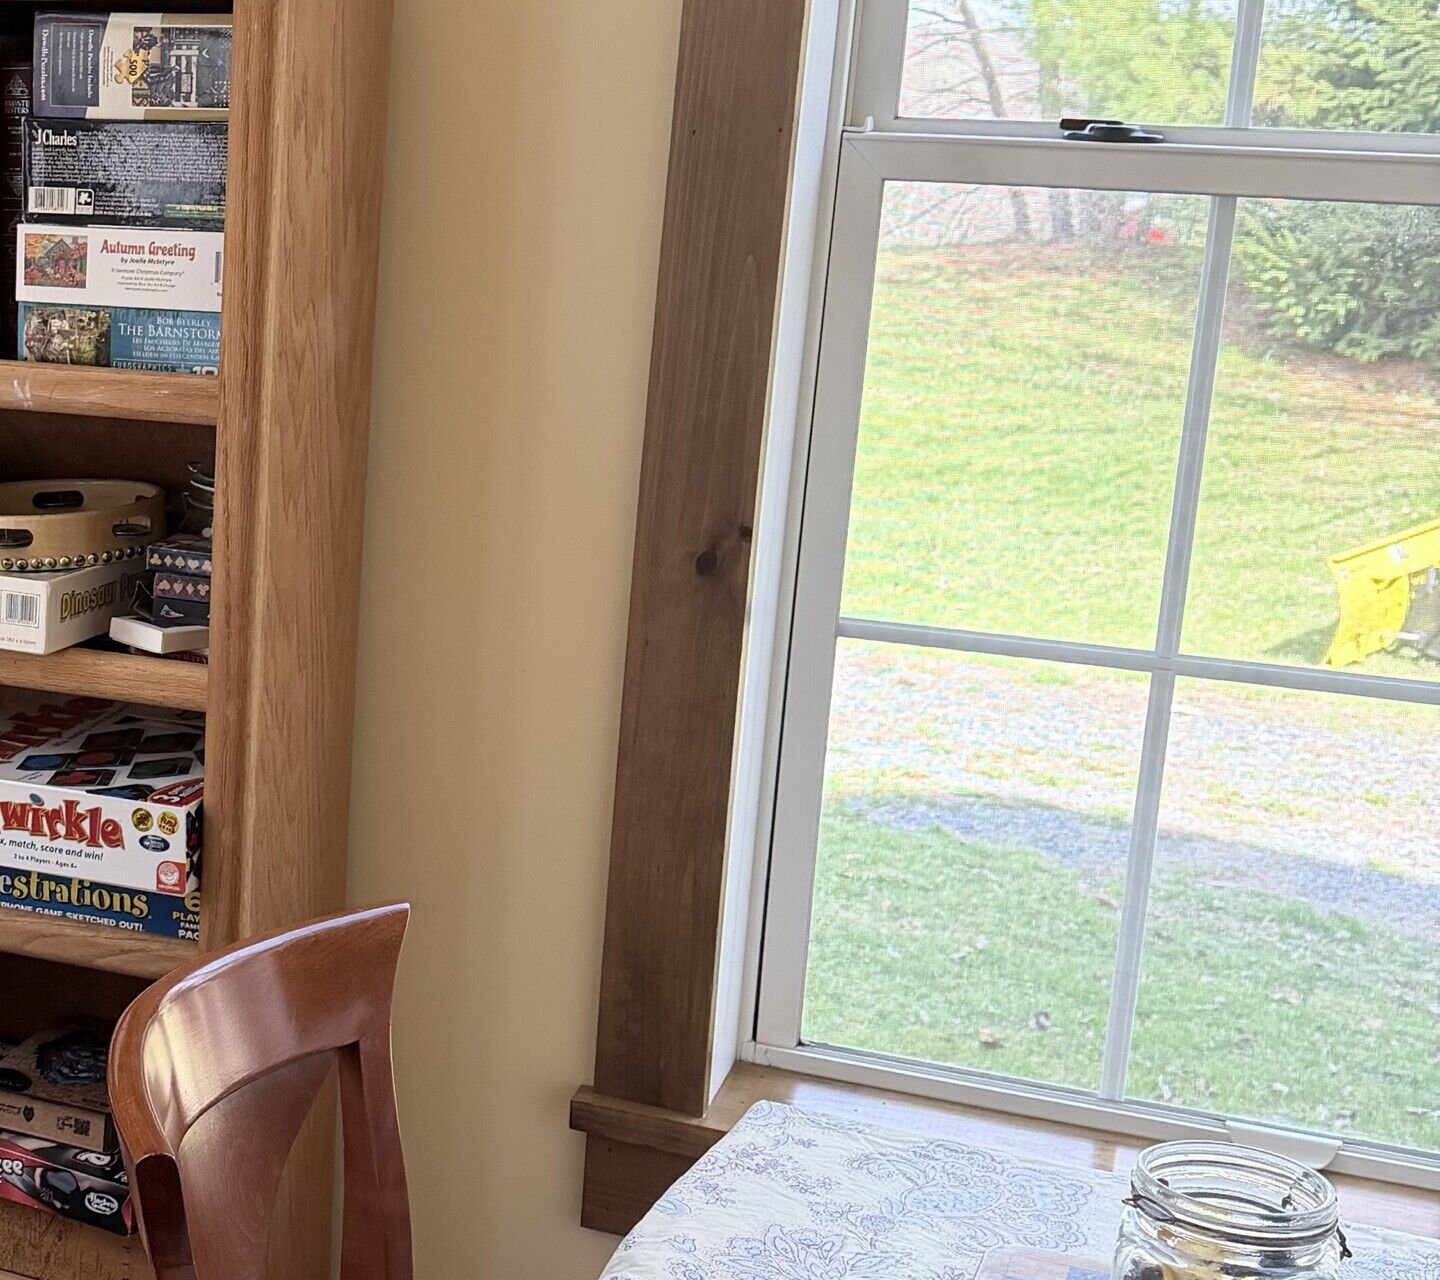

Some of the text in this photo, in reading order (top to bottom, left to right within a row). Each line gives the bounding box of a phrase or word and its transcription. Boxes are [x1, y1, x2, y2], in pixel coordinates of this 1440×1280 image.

[128, 58, 138, 77] 500
[43, 130, 78, 147] Charles
[100, 239, 196, 261] Autumn Greeting
[120, 257, 128, 265] by
[128, 257, 147, 265] Joelle
[118, 323, 144, 336] THE
[176, 317, 211, 328] BYERLEY
[61, 582, 117, 621] Dinosaur
[8, 839, 39, 852] match,
[40, 844, 64, 855] score
[65, 848, 83, 858] and
[84, 851, 104, 862] win!
[35, 907, 64, 917] GAME
[65, 912, 117, 927] SKETCHED
[118, 921, 144, 932] OUT!
